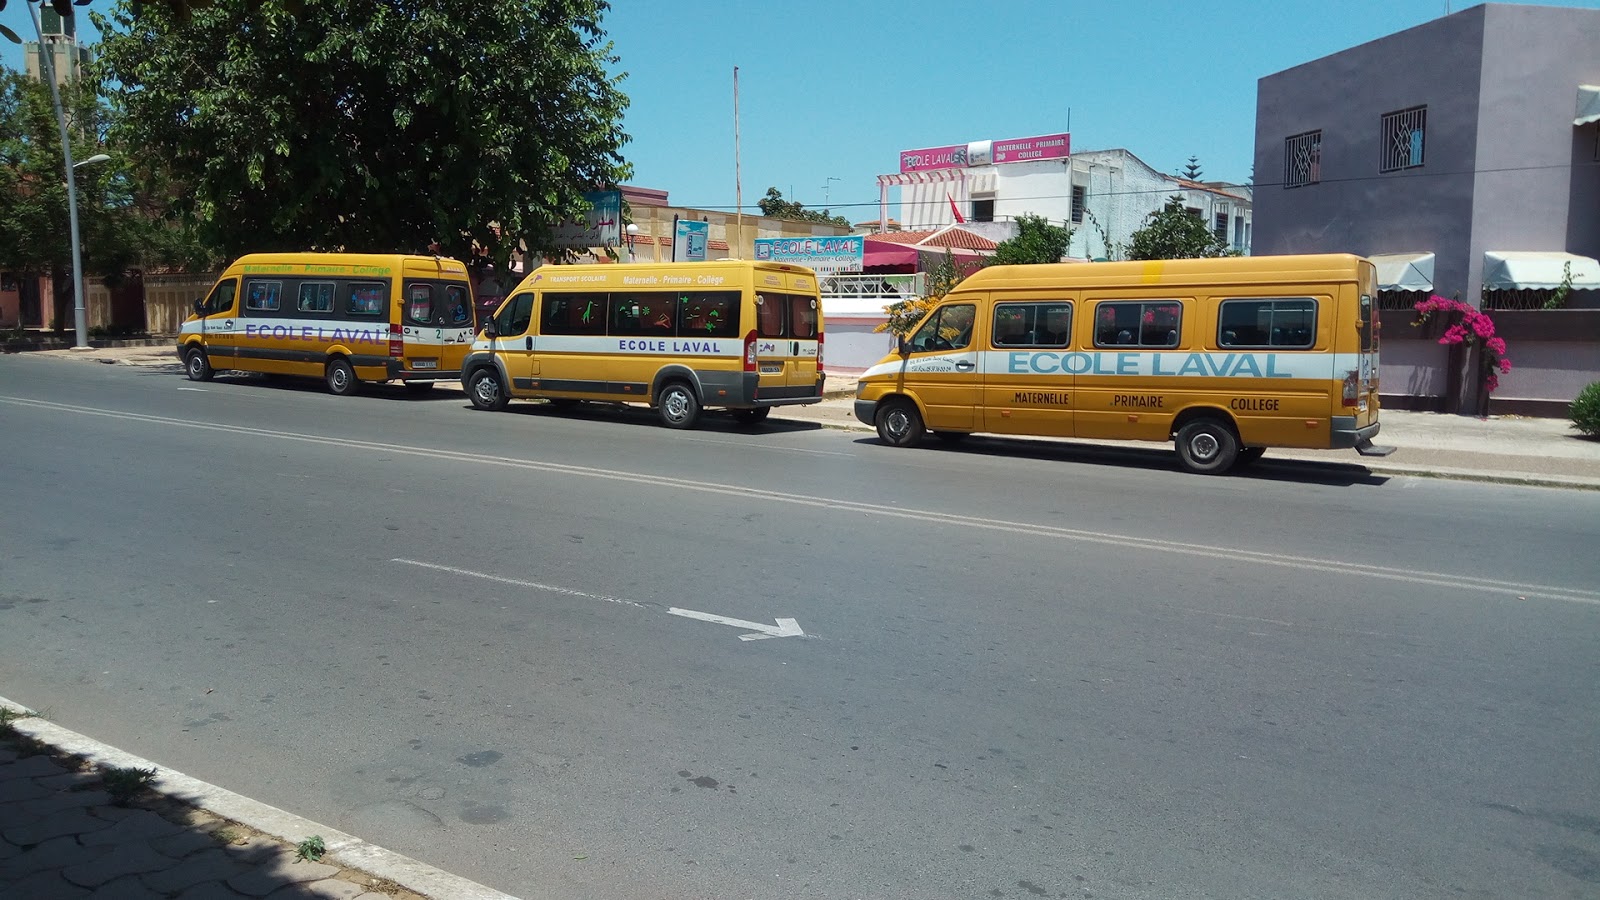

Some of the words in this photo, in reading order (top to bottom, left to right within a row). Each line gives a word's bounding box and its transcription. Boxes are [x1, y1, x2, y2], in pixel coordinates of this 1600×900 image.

[997, 143, 1031, 152] MATERNELLE
[1036, 138, 1064, 148] PRIMAIRE
[907, 154, 930, 167] ECOLE
[931, 151, 956, 165] LAVAL
[773, 240, 812, 255] ECOLE
[816, 240, 857, 254] LAVAL
[244, 265, 293, 273] Maternelle
[304, 265, 345, 273] Primaire
[622, 275, 658, 285] Maternelle
[662, 275, 691, 284] Primaire
[697, 275, 724, 286] Collège
[245, 324, 313, 341] ECOLE
[318, 327, 387, 346] LAVAL
[435, 328, 441, 339] 2
[619, 340, 666, 352] ECOLE
[673, 341, 721, 353] LAVAL
[1008, 352, 1140, 375] ECOLE
[1152, 352, 1293, 379] LAVAL
[1014, 392, 1069, 405] MATERNELLE
[1113, 394, 1163, 408] PRIMAIRE
[1230, 398, 1280, 411] COLLEGE
